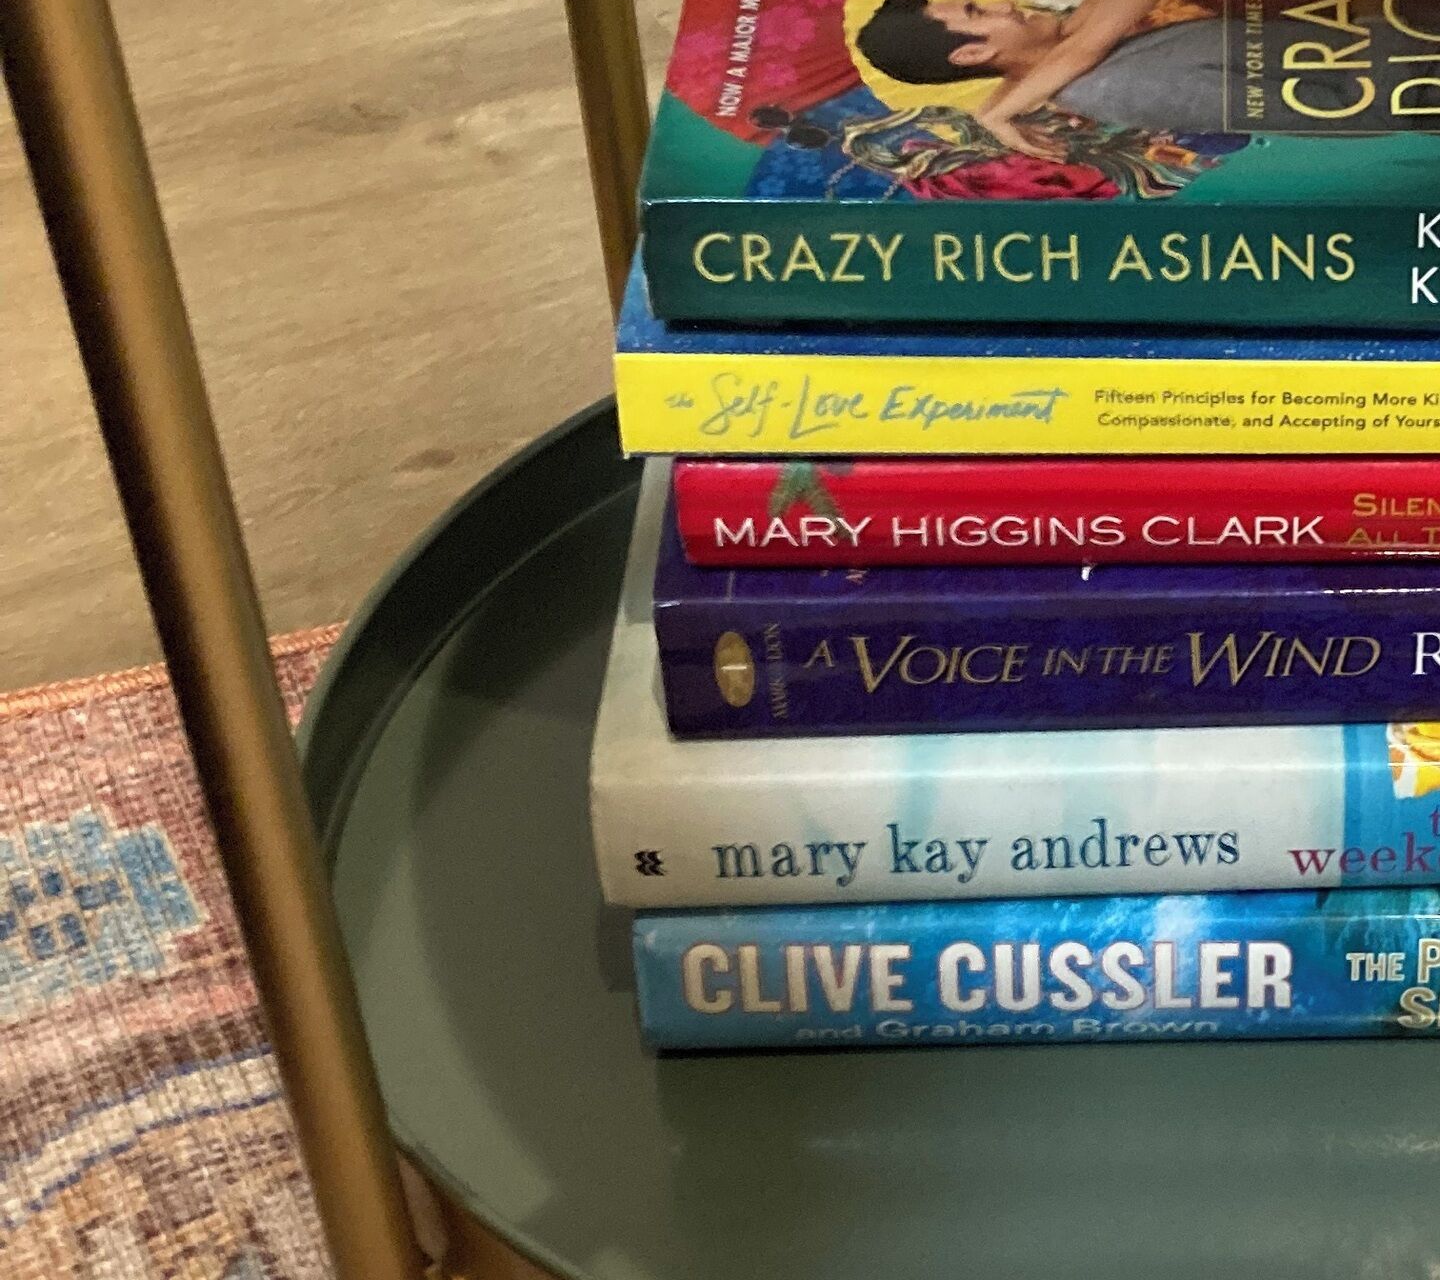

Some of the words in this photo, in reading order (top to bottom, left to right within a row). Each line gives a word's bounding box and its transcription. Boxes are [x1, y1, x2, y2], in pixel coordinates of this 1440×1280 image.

[729, 15, 757, 63] MAJOR
[726, 65, 748, 77] A
[1246, 41, 1265, 80] YORK
[716, 82, 743, 117] NOW
[1246, 86, 1265, 119] NEW
[692, 232, 904, 283] CRAZY
[932, 232, 1080, 283] RICH
[1108, 232, 1356, 283] ASIANS
[699, 372, 869, 439] Self-Love
[879, 386, 1069, 431] Experiment
[1094, 389, 1156, 404] Fifteen
[1161, 390, 1245, 408] Principles
[1251, 391, 1276, 405] for
[1282, 391, 1366, 409] Becoming
[1372, 393, 1417, 406] More
[1097, 413, 1237, 431] Compassionate,
[1242, 414, 1274, 427] and
[1279, 415, 1366, 431] Accepting
[1372, 414, 1391, 428] of
[713, 516, 873, 548] MARY
[892, 516, 1126, 548] HIGGINS
[1142, 515, 1326, 546] CLARK
[1346, 527, 1400, 546] ALL
[803, 639, 836, 669] A
[849, 634, 1034, 693] VOICE
[1042, 646, 1092, 676] IN
[1098, 645, 1176, 675] THE
[1185, 631, 1382, 688] WIND
[711, 841, 868, 888] mary
[886, 823, 992, 884] kay
[1010, 818, 1241, 871] andrews
[682, 941, 914, 1014] CLIVE
[938, 940, 1293, 1013] CUSSLER
[1346, 951, 1406, 982] THE
[795, 1022, 864, 1040] and
[875, 1019, 1056, 1040] Graham
[1071, 1018, 1219, 1036] Brown
